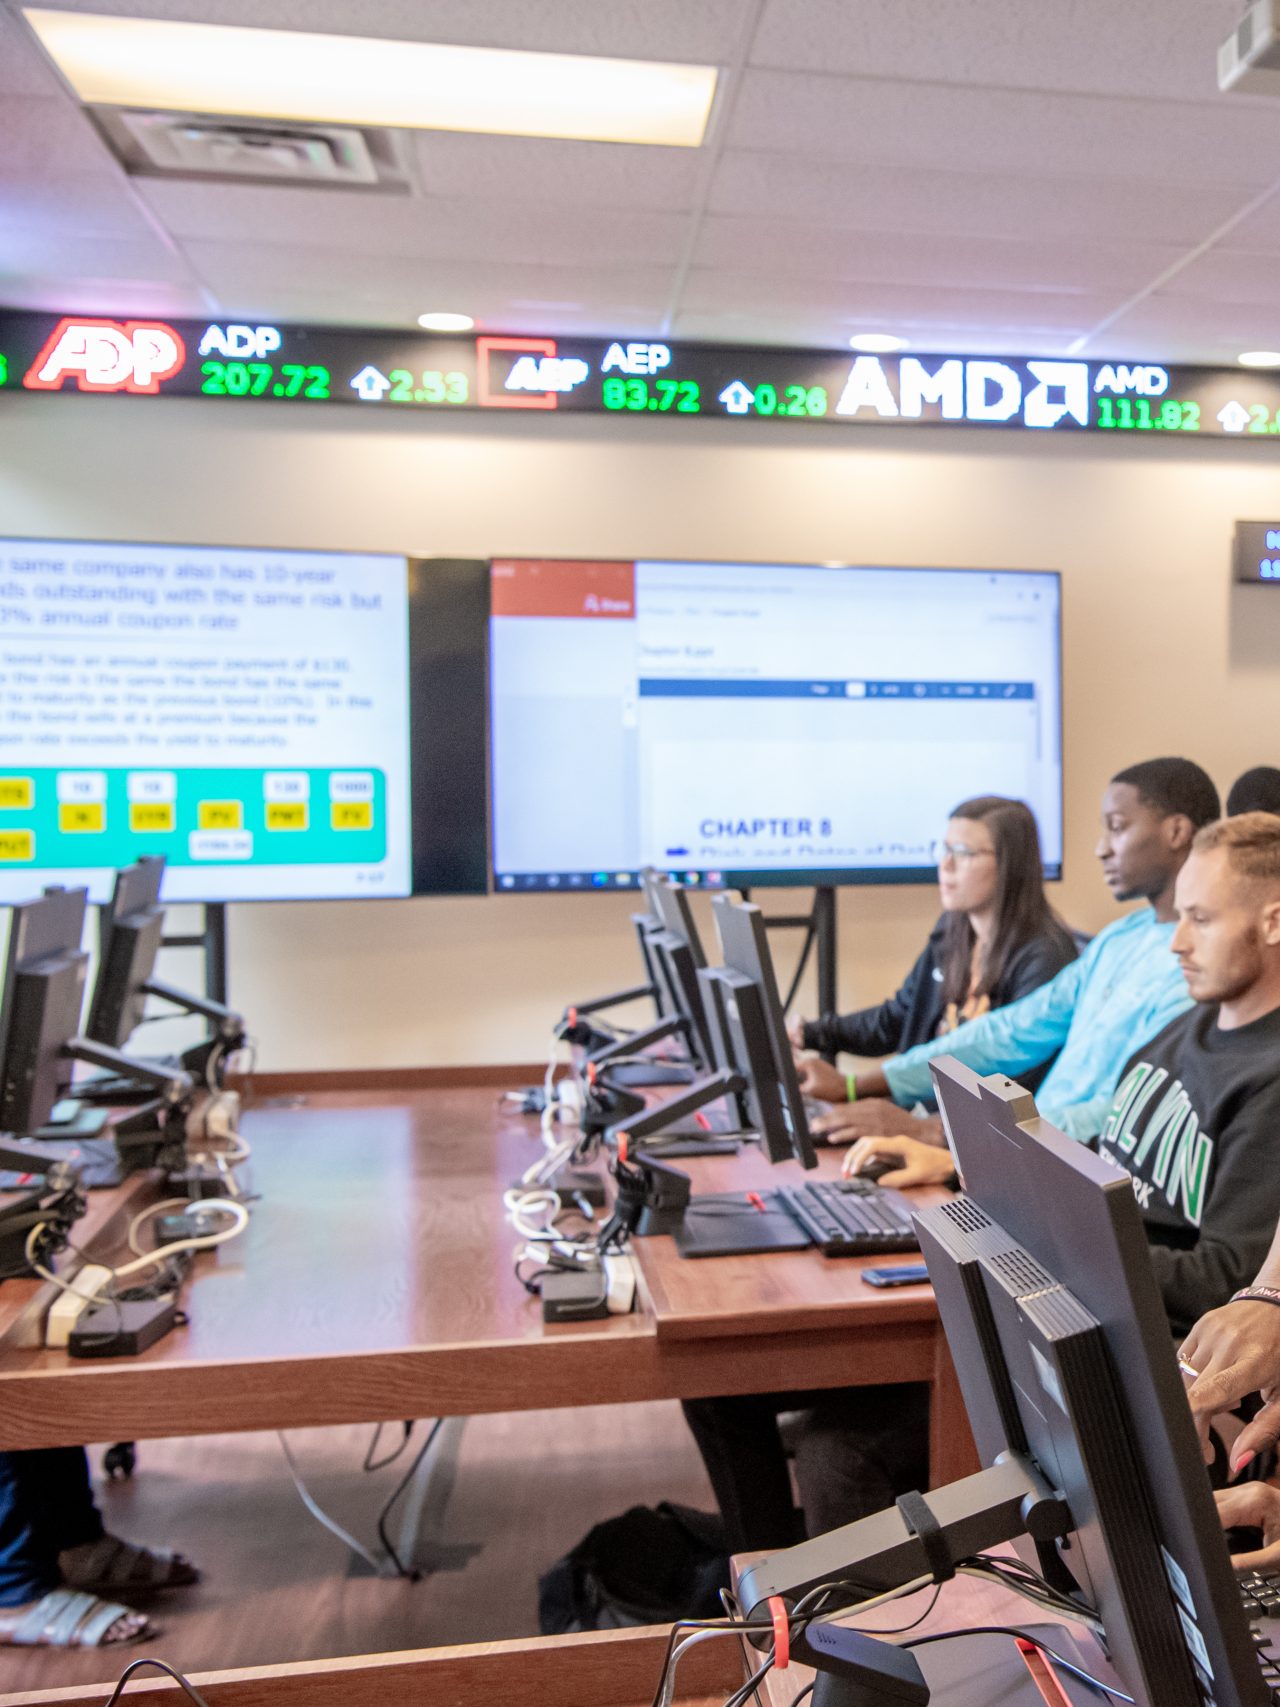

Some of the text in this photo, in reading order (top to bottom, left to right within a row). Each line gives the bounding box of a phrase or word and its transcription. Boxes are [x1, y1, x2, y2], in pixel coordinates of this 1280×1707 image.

[25, 319, 186, 393] ADP
[200, 324, 281, 358] ADP
[602, 343, 671, 374] AEP
[201, 361, 330, 398] 207.72
[603, 378, 699, 412] 83.72
[836, 356, 1021, 420] AMD
[1094, 365, 1168, 395] AMD
[1098, 398, 1200, 431] 111.82
[700, 818, 833, 839] CHAPTER 8
[1101, 1062, 1214, 1228] ALVIN
